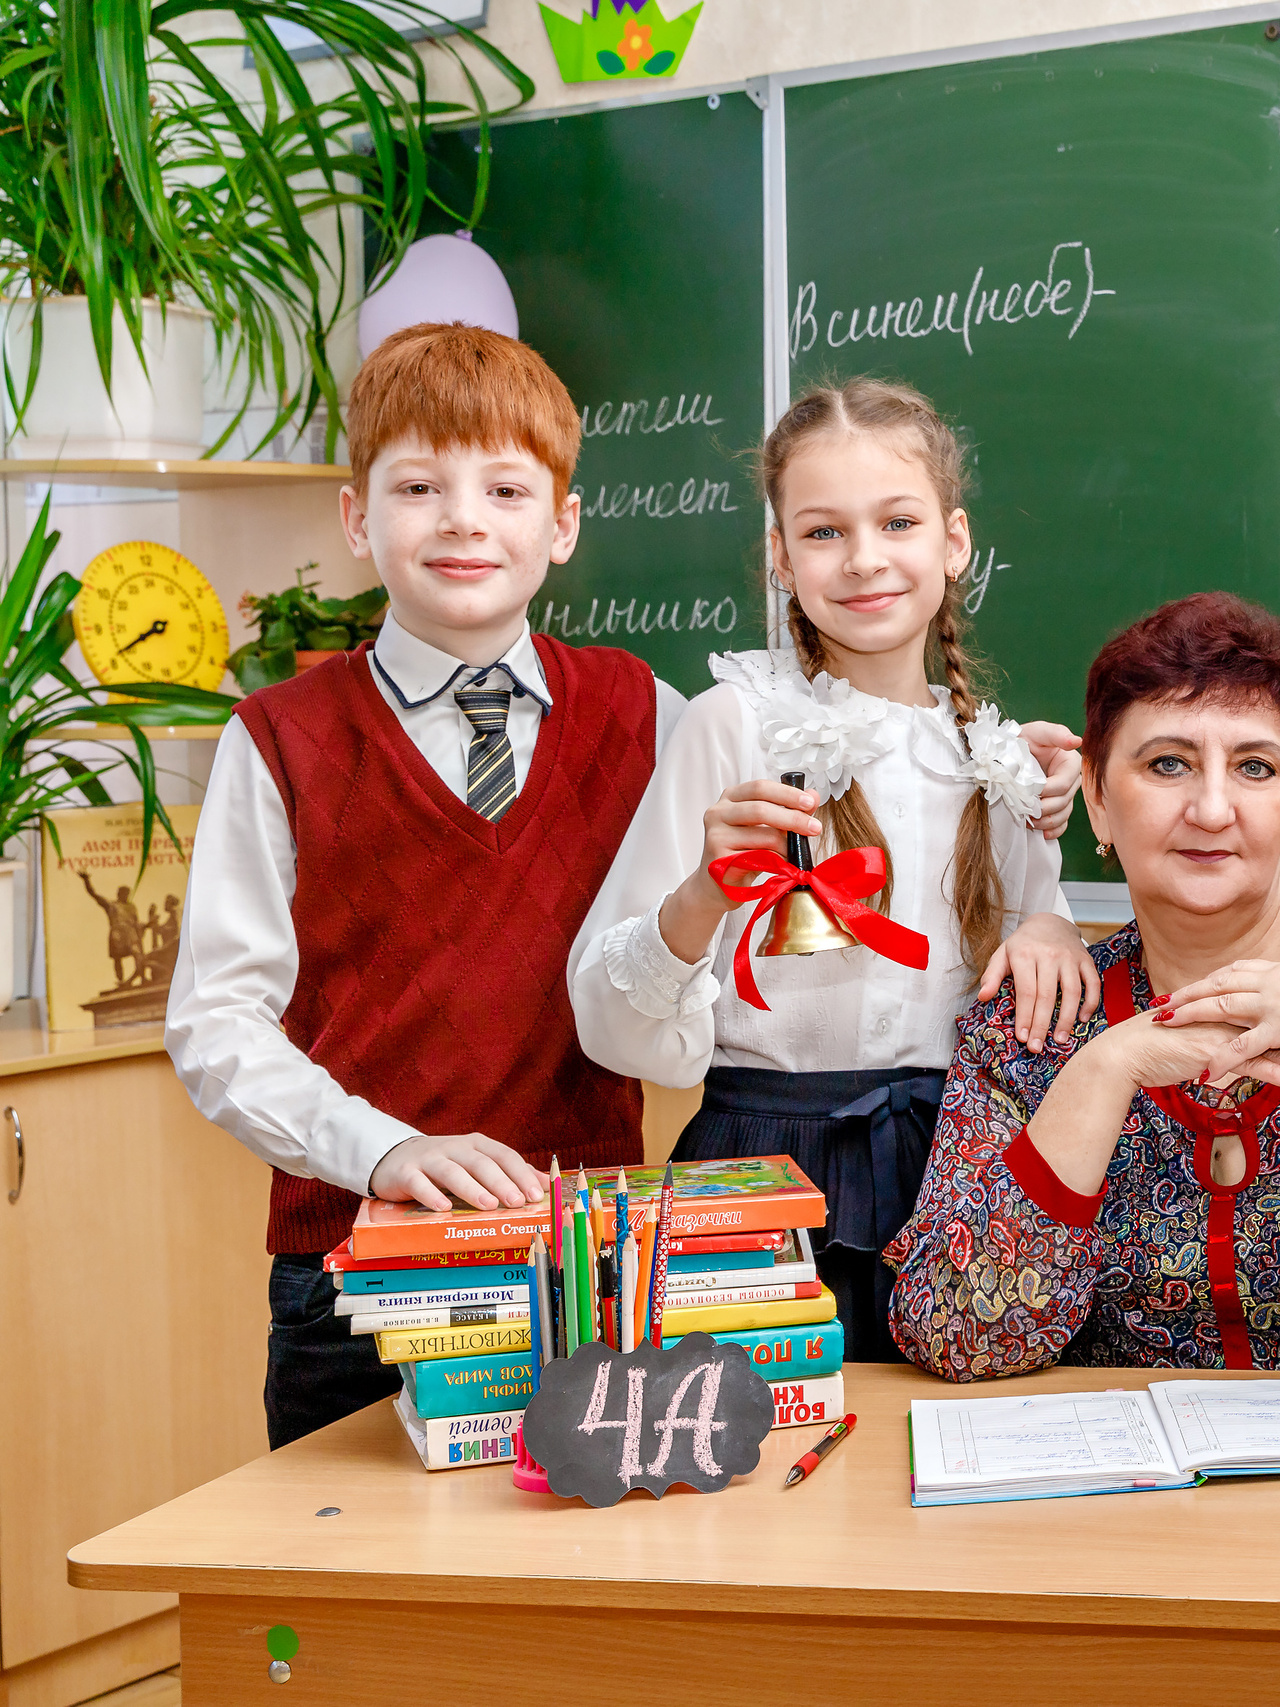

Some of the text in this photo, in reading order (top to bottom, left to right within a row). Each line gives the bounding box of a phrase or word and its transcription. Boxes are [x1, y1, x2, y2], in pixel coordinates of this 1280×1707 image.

[444, 1227, 497, 1240] Лариса
[377, 1290, 515, 1307] Моя первая книга
[738, 1288, 785, 1300] ОСНОВЫ
[408, 1329, 532, 1355] ЖИВОТНЫХ
[444, 1368, 493, 1386] МИРА
[448, 1415, 512, 1441] детей
